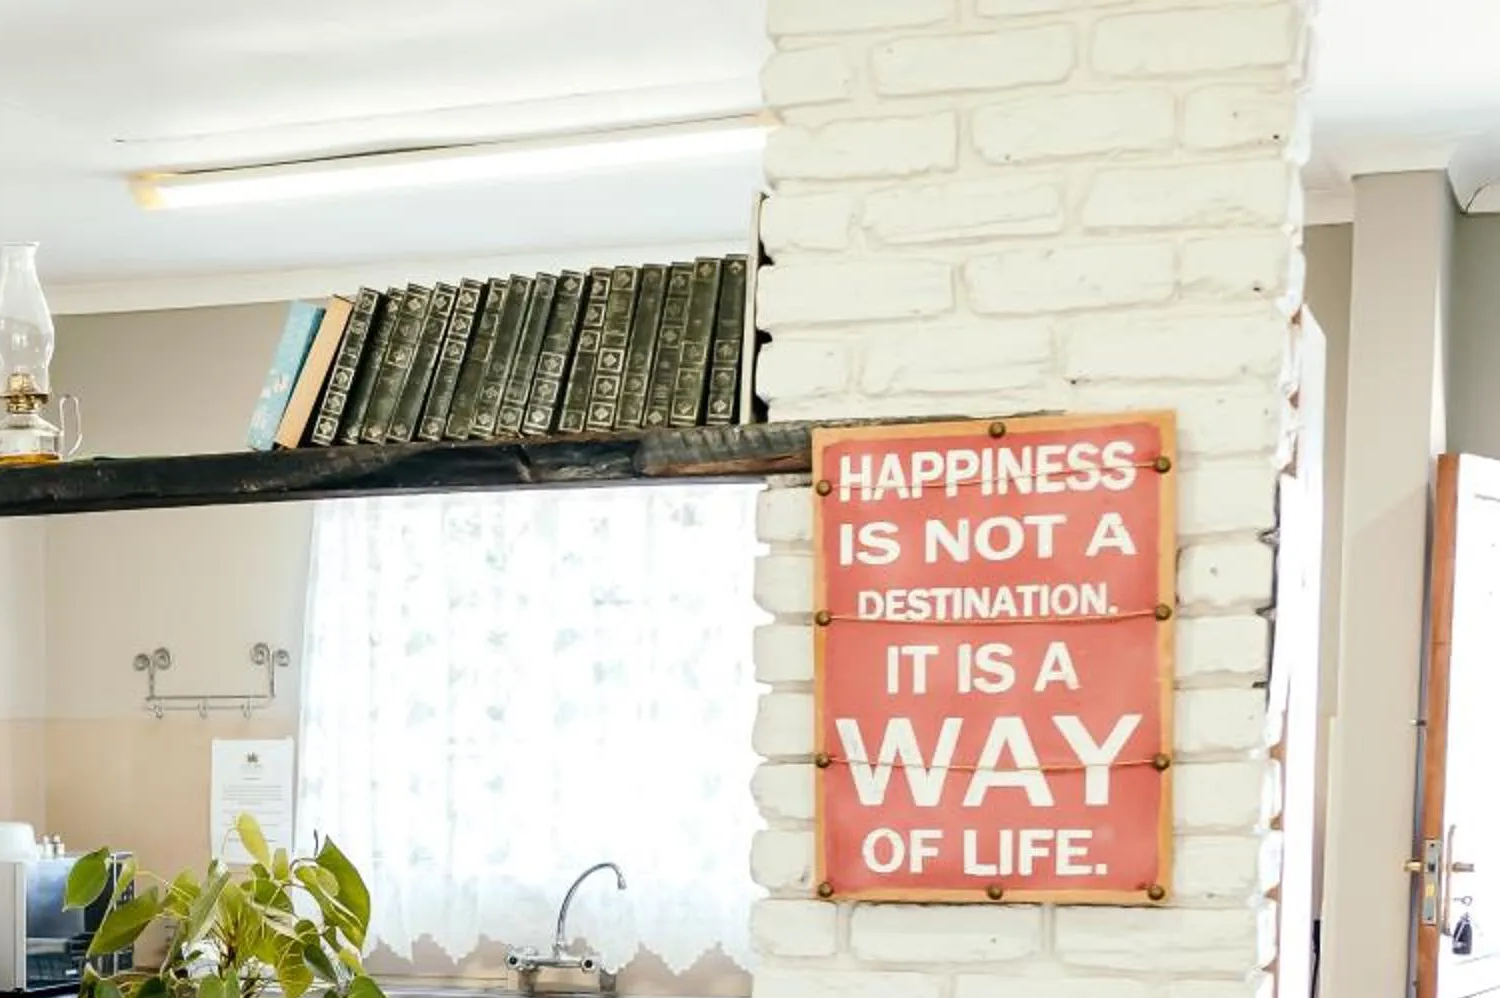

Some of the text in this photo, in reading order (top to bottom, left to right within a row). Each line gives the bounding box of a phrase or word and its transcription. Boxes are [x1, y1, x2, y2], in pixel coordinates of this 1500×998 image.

[839, 441, 1139, 502] HAPPINESS
[839, 512, 1137, 565] IS NOT A
[858, 583, 1118, 621] DESTINATION.
[886, 641, 1083, 694] IT IS A
[835, 713, 1143, 807] WAY
[862, 827, 1108, 876] OF LIFE.
